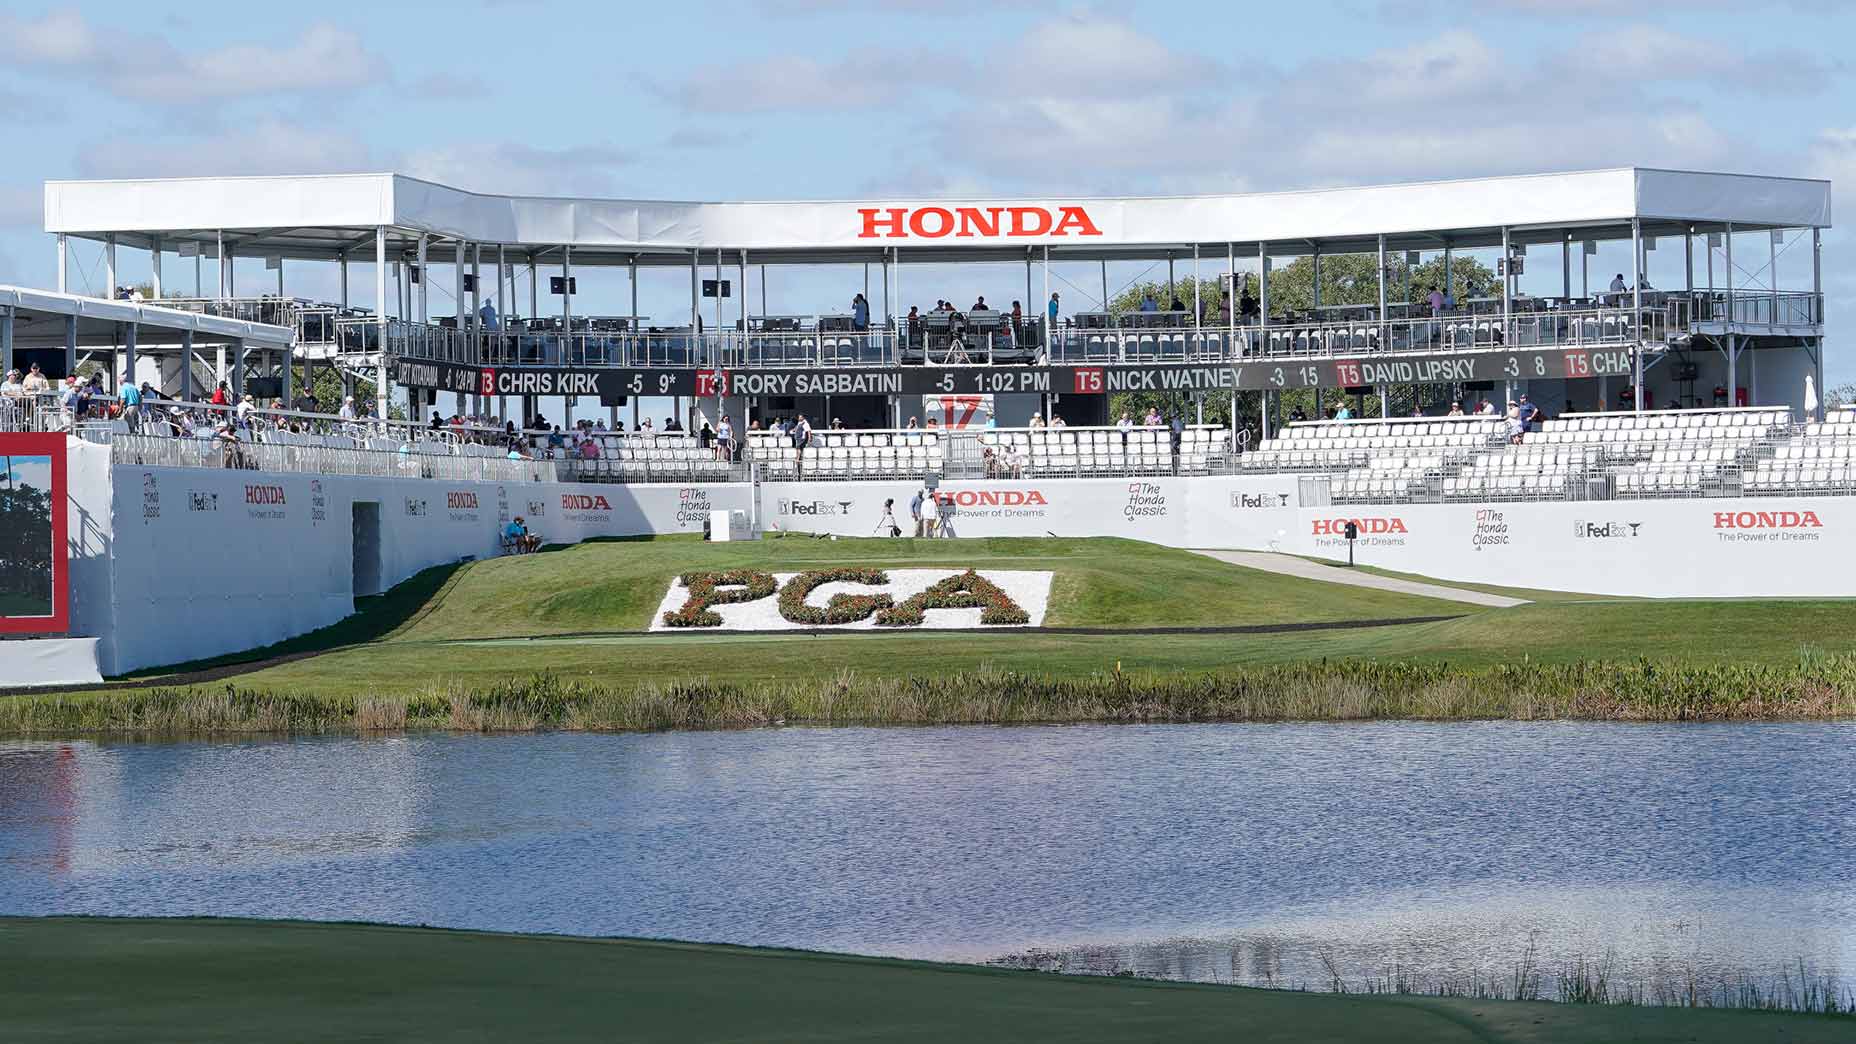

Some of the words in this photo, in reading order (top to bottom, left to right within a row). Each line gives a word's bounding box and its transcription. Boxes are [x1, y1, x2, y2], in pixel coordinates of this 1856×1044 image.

[857, 206, 1103, 238] HONDA
[1337, 365, 1359, 385] T5
[1363, 362, 1413, 383] DAVID
[1415, 359, 1475, 381] LIPSKY
[1504, 357, 1519, 377] -3
[1535, 356, 1545, 376] 8
[1566, 354, 1588, 374] T5
[1593, 352, 1631, 373] CHA
[411, 364, 438, 387] KITAYAMA
[482, 372, 493, 393] T3
[498, 373, 552, 393] CHRIS
[556, 373, 600, 393] KIRK
[627, 374, 643, 393] -5
[733, 374, 790, 394] RORY
[795, 373, 902, 393] SABBATINI
[936, 373, 954, 392] -5
[975, 372, 1014, 392] 1:02
[1020, 372, 1049, 392] PM
[1077, 371, 1101, 390] T5
[1107, 370, 1155, 390] NICK
[1160, 367, 1243, 389] WATNEY
[1269, 367, 1285, 386] -3
[1300, 366, 1318, 386] 15
[245, 485, 286, 504] HONDA
[690, 488, 706, 500] The
[1142, 483, 1161, 495] The
[448, 492, 478, 508] HONDA
[561, 495, 612, 510] HONDA
[680, 500, 710, 510] Honda
[934, 491, 1047, 506] HONDA
[1129, 494, 1165, 505] Honda
[957, 509, 990, 518] Power
[991, 509, 1002, 517] of
[1004, 509, 1045, 518] Dreams
[1487, 510, 1503, 521] The
[1713, 511, 1823, 529] HONDA
[1312, 518, 1408, 535] HONDA
[1477, 522, 1508, 533] Honda
[1587, 522, 1626, 537] FedEx
[1316, 538, 1331, 546] The
[1333, 538, 1360, 546] Powr
[1361, 537, 1371, 545] of
[1372, 537, 1405, 545] Dreams
[1718, 532, 1735, 541] The
[1737, 532, 1767, 541] Power
[1769, 532, 1779, 541] of
[1781, 531, 1819, 541] Dreams
[663, 567, 1030, 627] PGA
